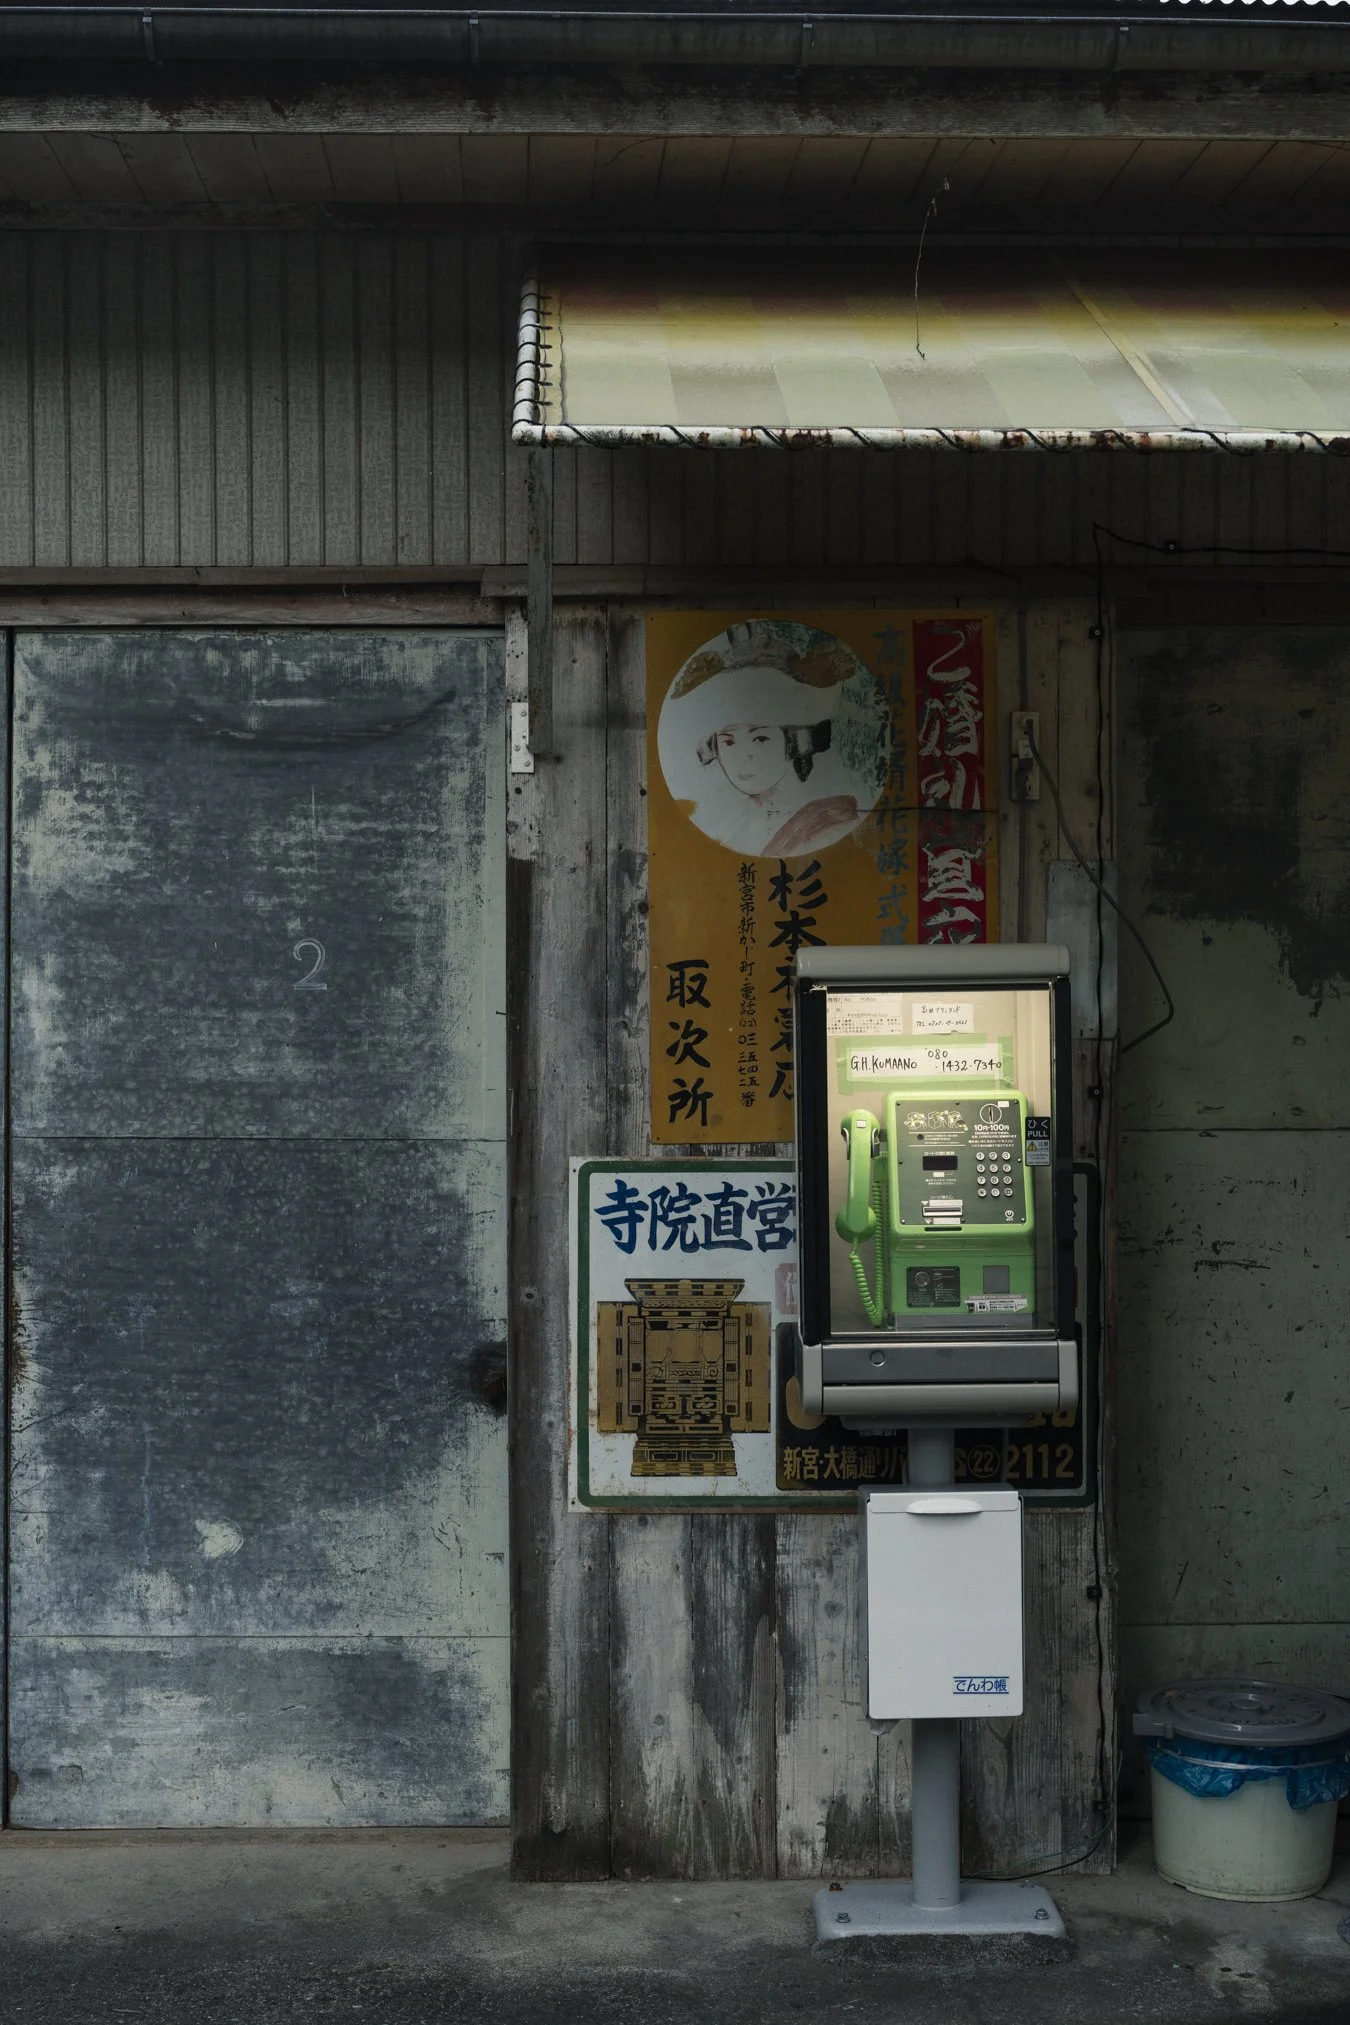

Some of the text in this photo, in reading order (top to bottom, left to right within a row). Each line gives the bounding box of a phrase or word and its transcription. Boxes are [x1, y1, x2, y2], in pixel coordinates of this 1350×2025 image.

[292, 937, 328, 991] 2
[666, 959, 714, 1126] 取次所
[927, 1048, 949, 1060] 080
[1027, 1119, 1048, 1129] ひく
[1027, 1130, 1048, 1138] PULL
[594, 1178, 794, 1254] 寺院直営
[1005, 1442, 1075, 1479] 2112
[954, 1679, 1007, 1692] でんわ帳
